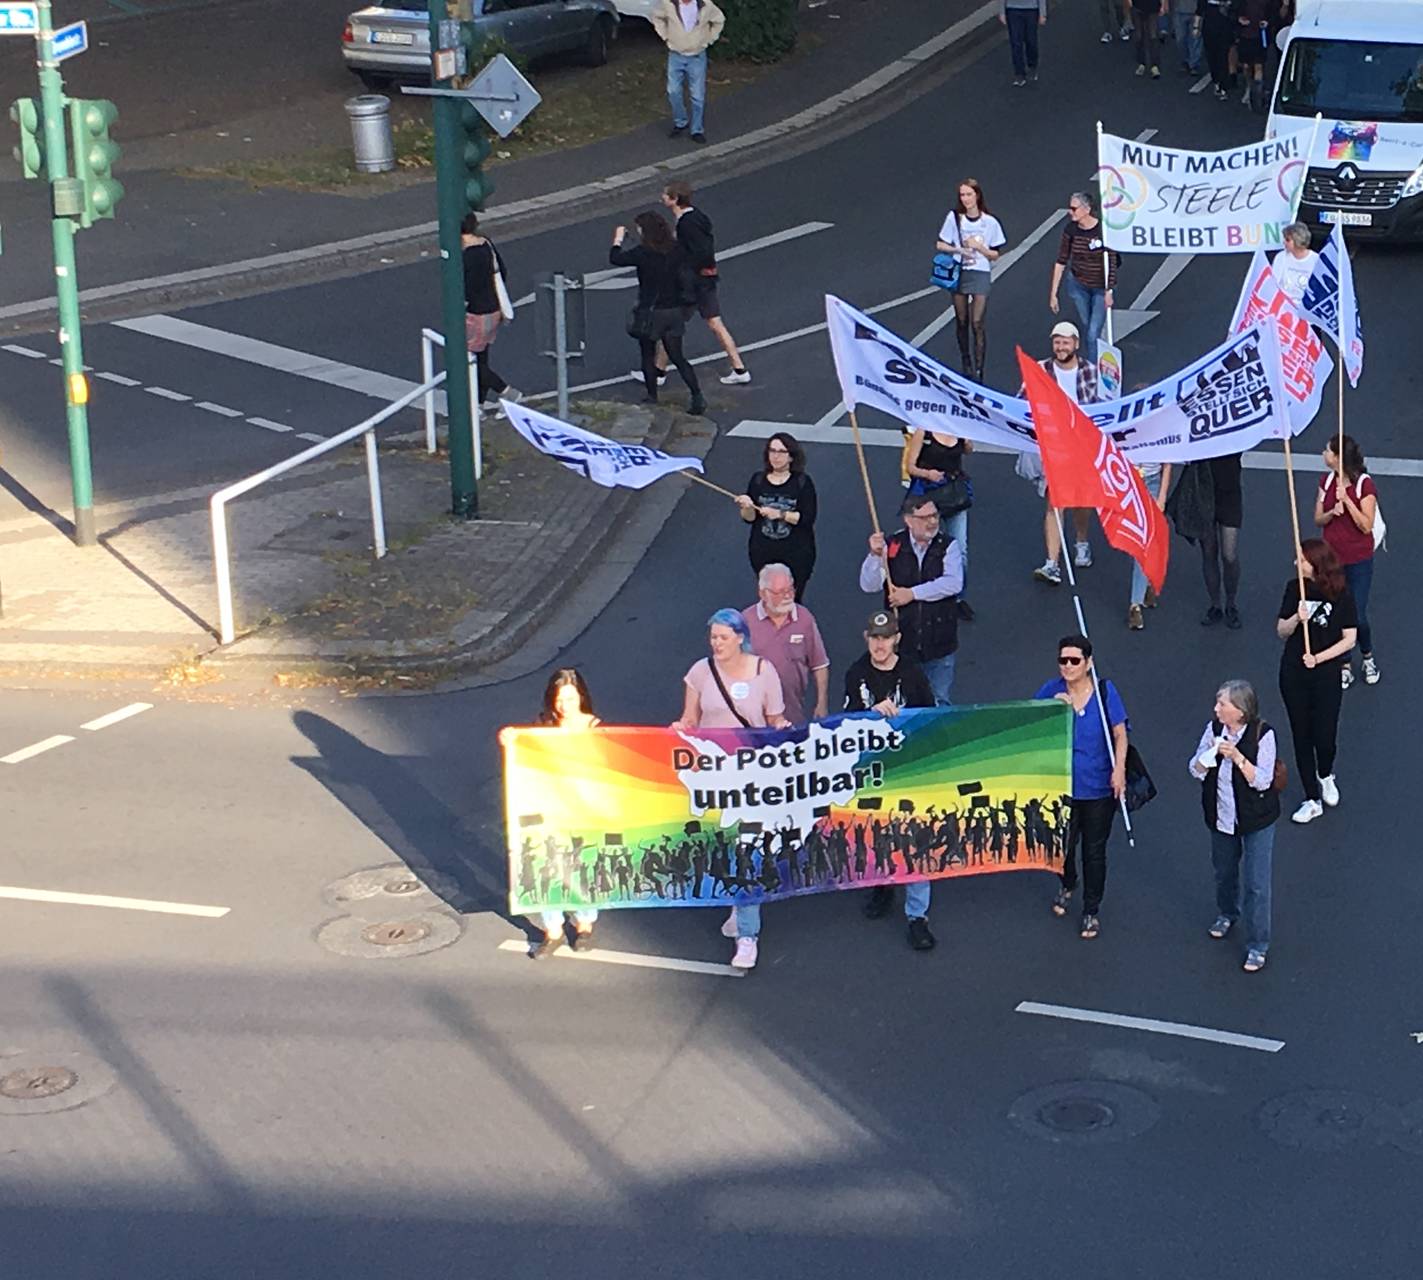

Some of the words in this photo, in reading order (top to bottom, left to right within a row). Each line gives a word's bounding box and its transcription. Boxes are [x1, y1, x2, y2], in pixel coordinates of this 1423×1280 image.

[1121, 143, 1179, 172] MUT
[1185, 136, 1299, 174] MACHEN!
[1148, 177, 1273, 215] STEELE
[1132, 226, 1218, 247] BLEIBT
[904, 398, 947, 415] gegen
[1180, 362, 1265, 414] ESSEN
[1233, 376, 1268, 399] SICH
[1190, 385, 1274, 436] QUER
[672, 748, 726, 772] Der
[736, 745, 806, 771] Pott
[815, 729, 902, 761] bleibt
[693, 762, 884, 810] unteilbar!
